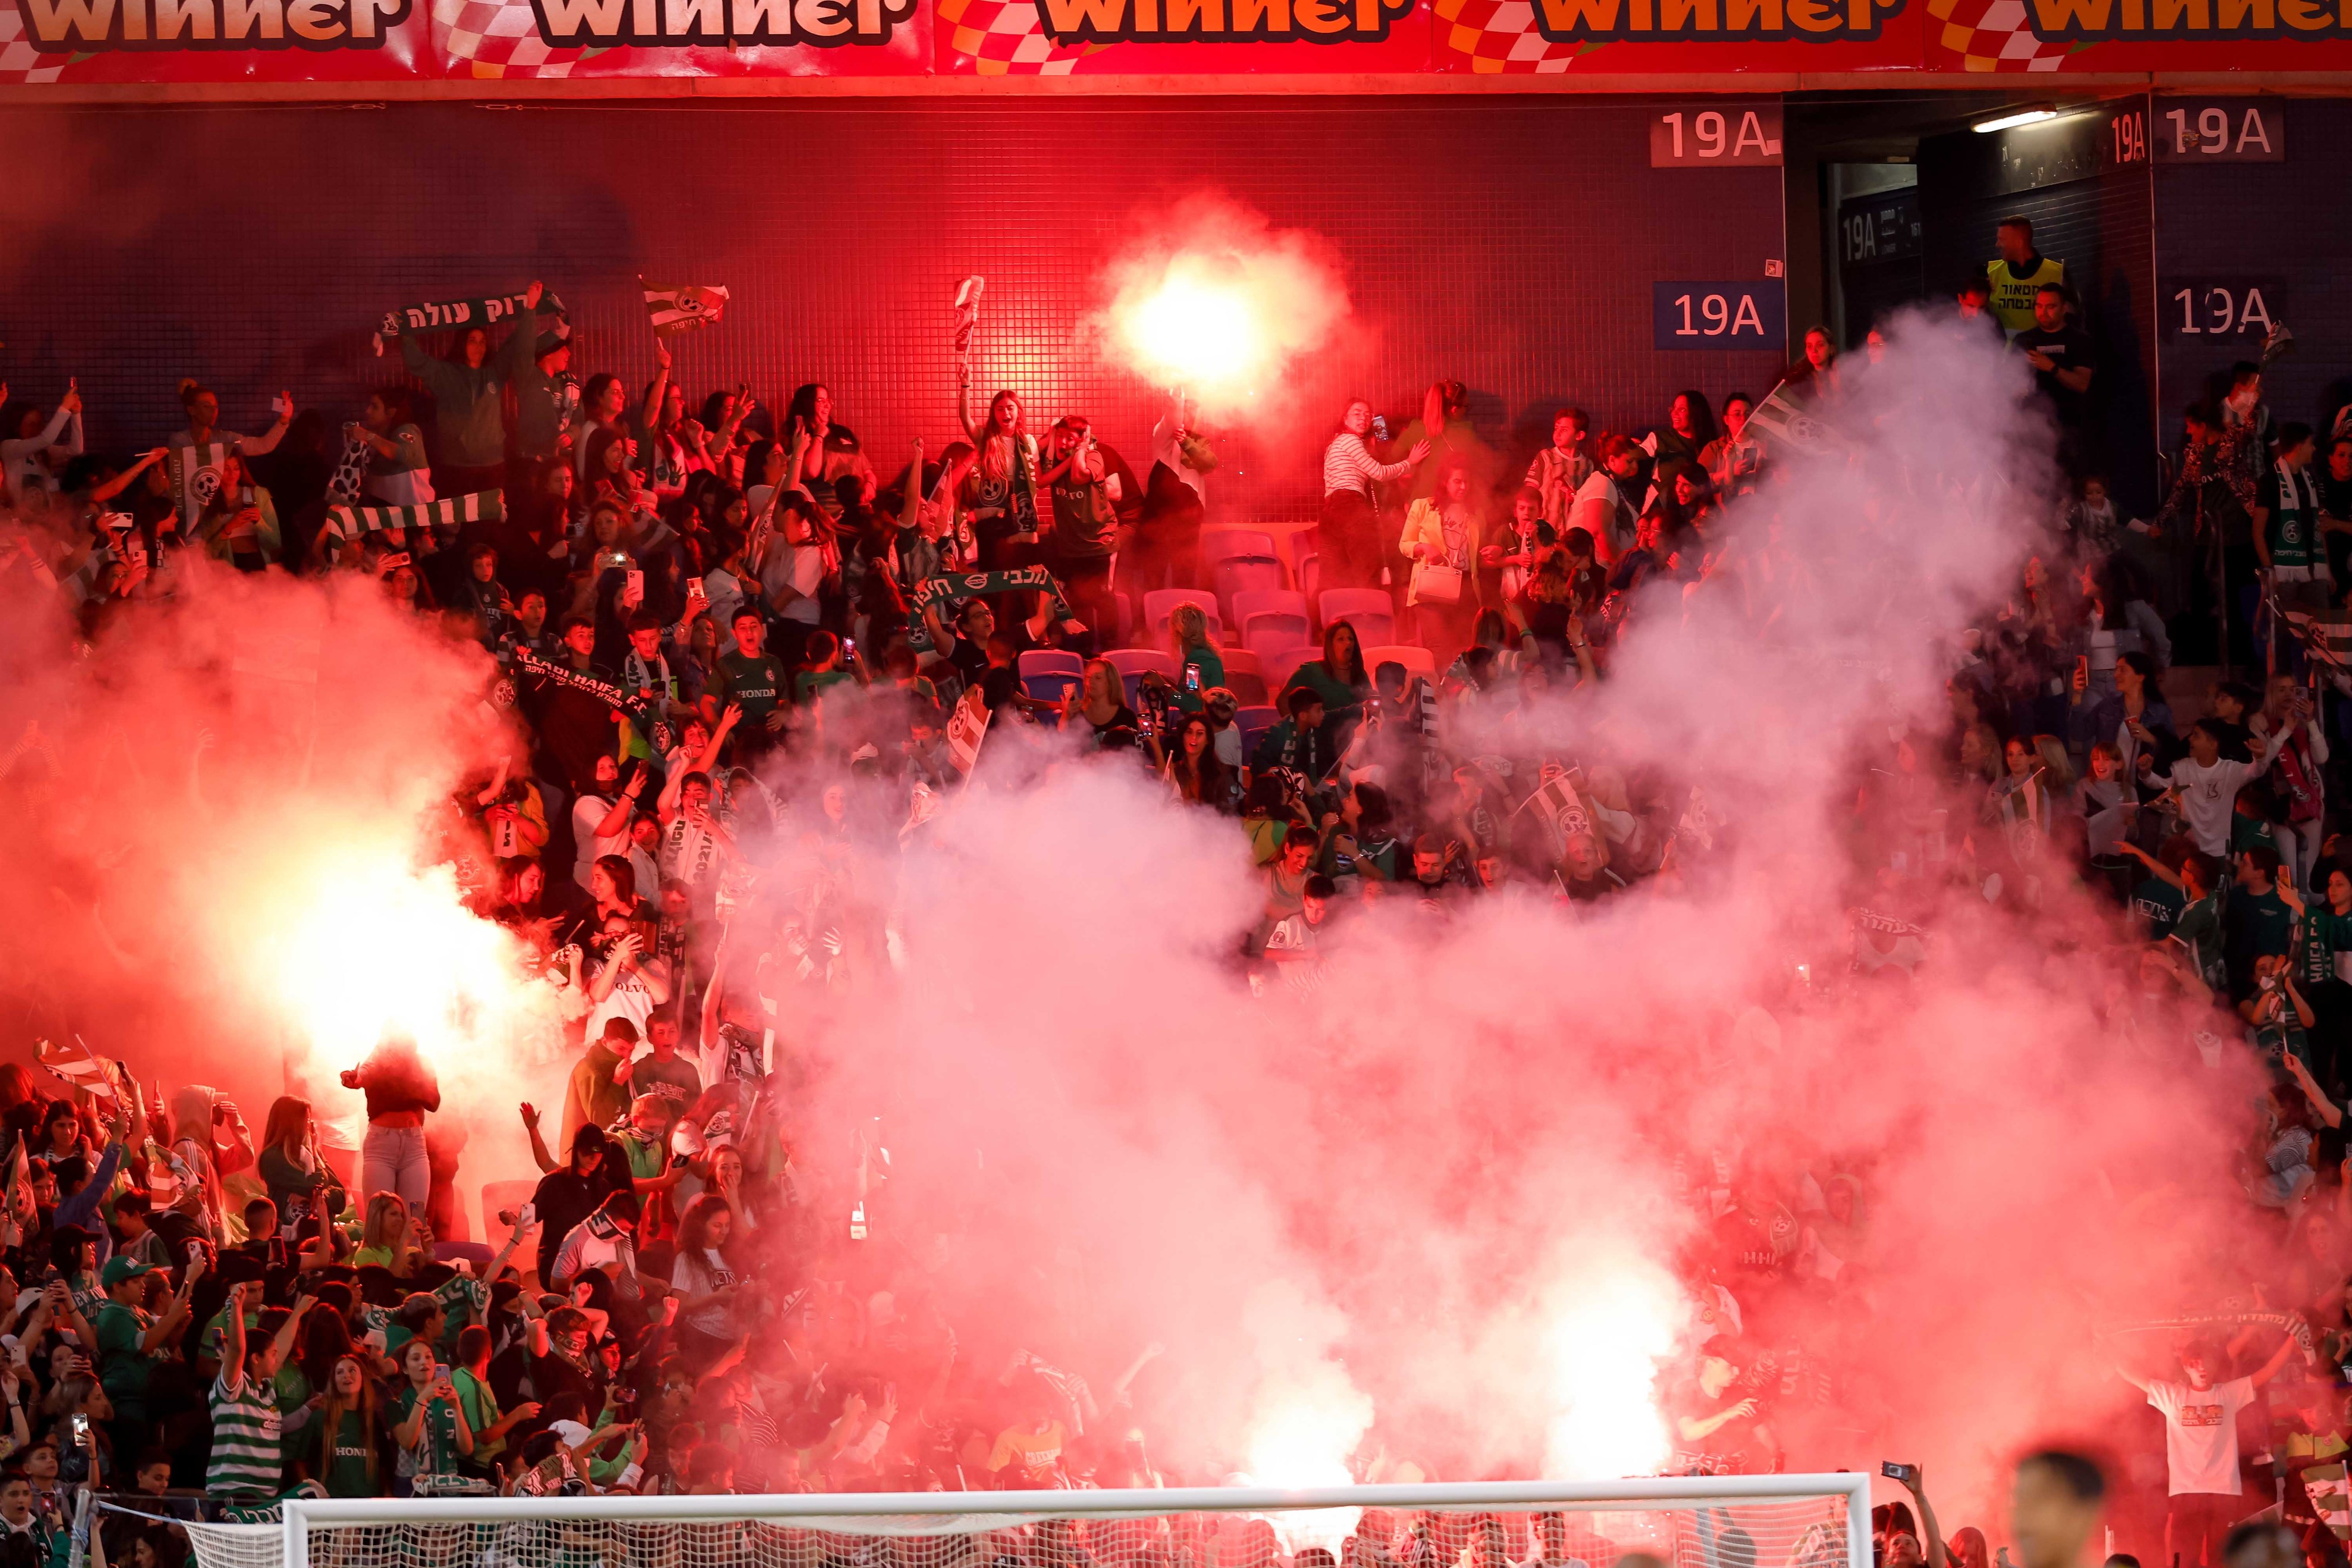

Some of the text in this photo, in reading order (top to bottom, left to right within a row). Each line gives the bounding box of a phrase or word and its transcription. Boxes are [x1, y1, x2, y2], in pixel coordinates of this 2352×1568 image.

[1662, 111, 1768, 158] 19A
[2112, 112, 2145, 163] 19A
[2166, 108, 2271, 154] 19A
[1843, 213, 1876, 261] 19A
[406, 294, 528, 328] רוק עולה
[1999, 298, 2036, 309] בטחה
[2174, 288, 2271, 335] 19A
[671, 319, 696, 330] חיפה
[1675, 294, 1765, 336] 19A
[1001, 570, 1048, 585] מכבי
[525, 664, 545, 675] חיפה
[574, 674, 624, 699] HAIFA
[736, 688, 776, 698] HONDA
[596, 692, 623, 707] מועדון
[613, 982, 650, 994] OLVO
[336, 1447, 378, 1457] HON
